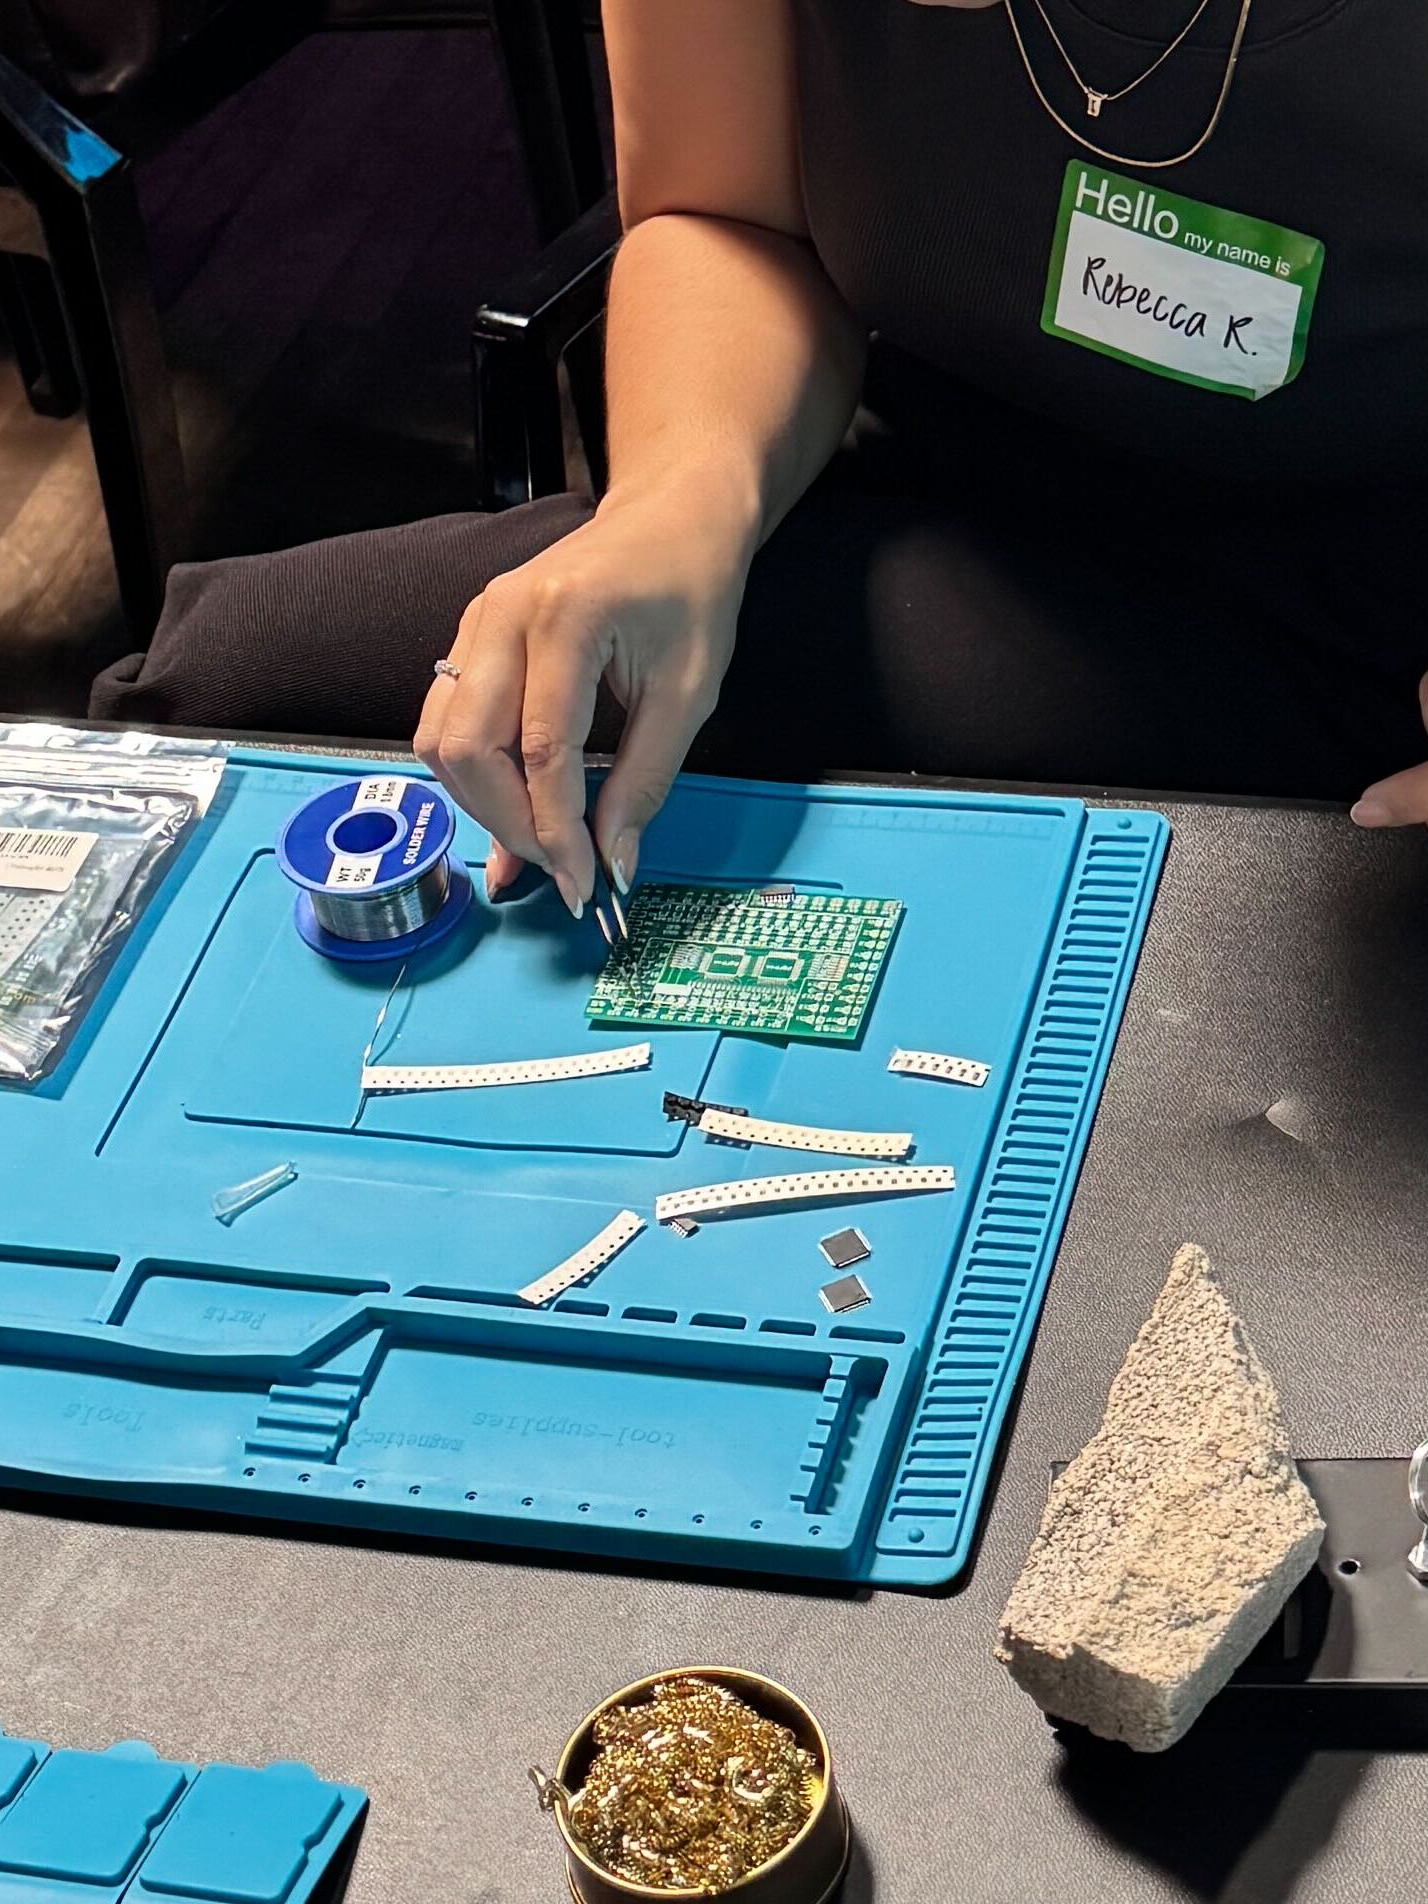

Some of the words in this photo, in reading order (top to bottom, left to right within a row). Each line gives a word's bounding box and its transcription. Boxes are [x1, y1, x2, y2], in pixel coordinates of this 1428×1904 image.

[1074, 171, 1180, 240] Hello
[1184, 230, 1214, 255] my
[1217, 240, 1270, 270] name
[1275, 256, 1292, 277] is
[1082, 255, 1208, 338] Rebecca
[364, 783, 380, 800] DIA
[402, 826, 427, 865] SOLDER
[415, 802, 435, 826] WIRE
[336, 867, 351, 882] WT
[202, 1305, 267, 1331] Parts
[62, 1402, 147, 1433] Tools
[471, 1410, 678, 1450] tool-supplies
